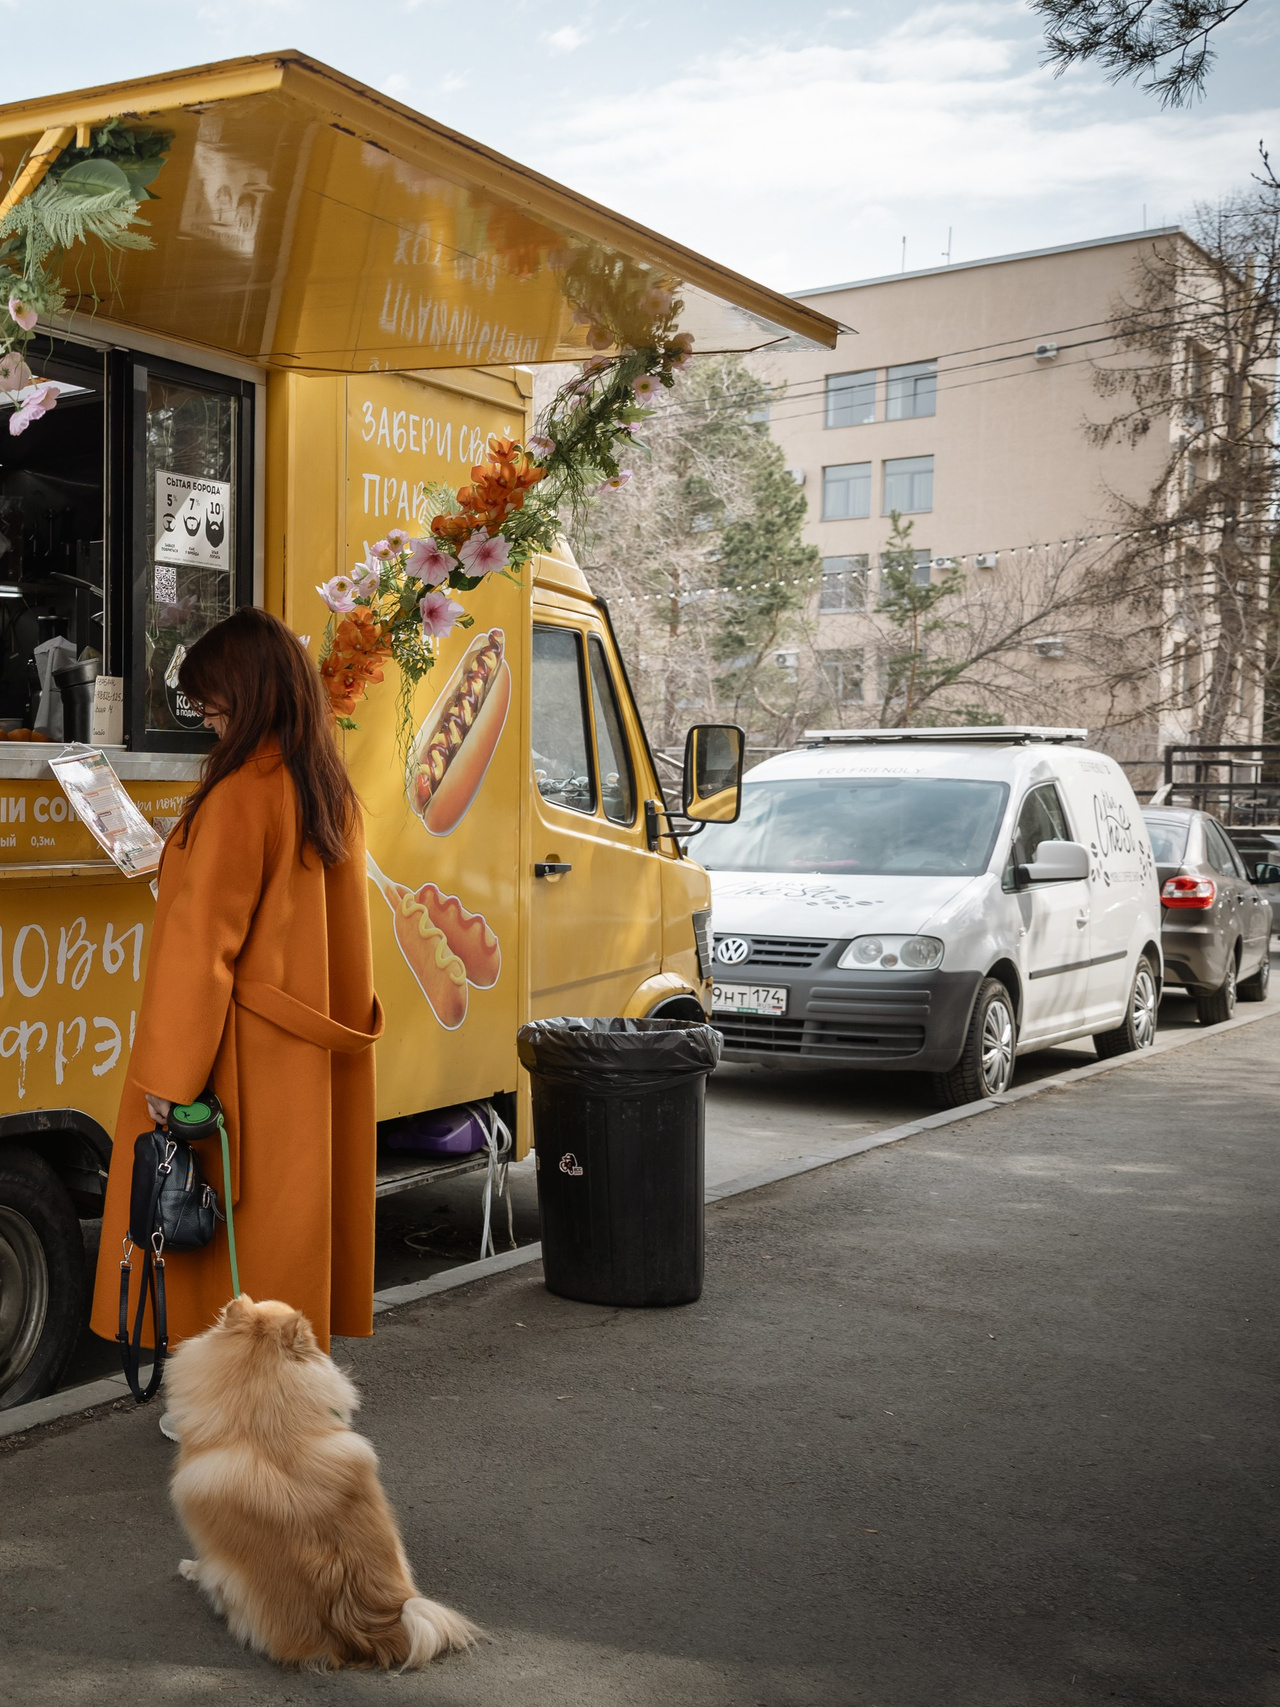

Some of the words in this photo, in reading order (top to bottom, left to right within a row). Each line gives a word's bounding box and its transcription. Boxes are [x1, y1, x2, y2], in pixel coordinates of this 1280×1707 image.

[361, 400, 452, 463] ЗАБЕРИ
[166, 477, 191, 489] СЫТАЯ
[192, 482, 221, 495] БОРОДА
[361, 473, 429, 525] ПРАВ
[849, 766, 926, 775] FRIENDLY
[30, 836, 56, 848] 0,3мл
[752, 988, 780, 1004] 174
